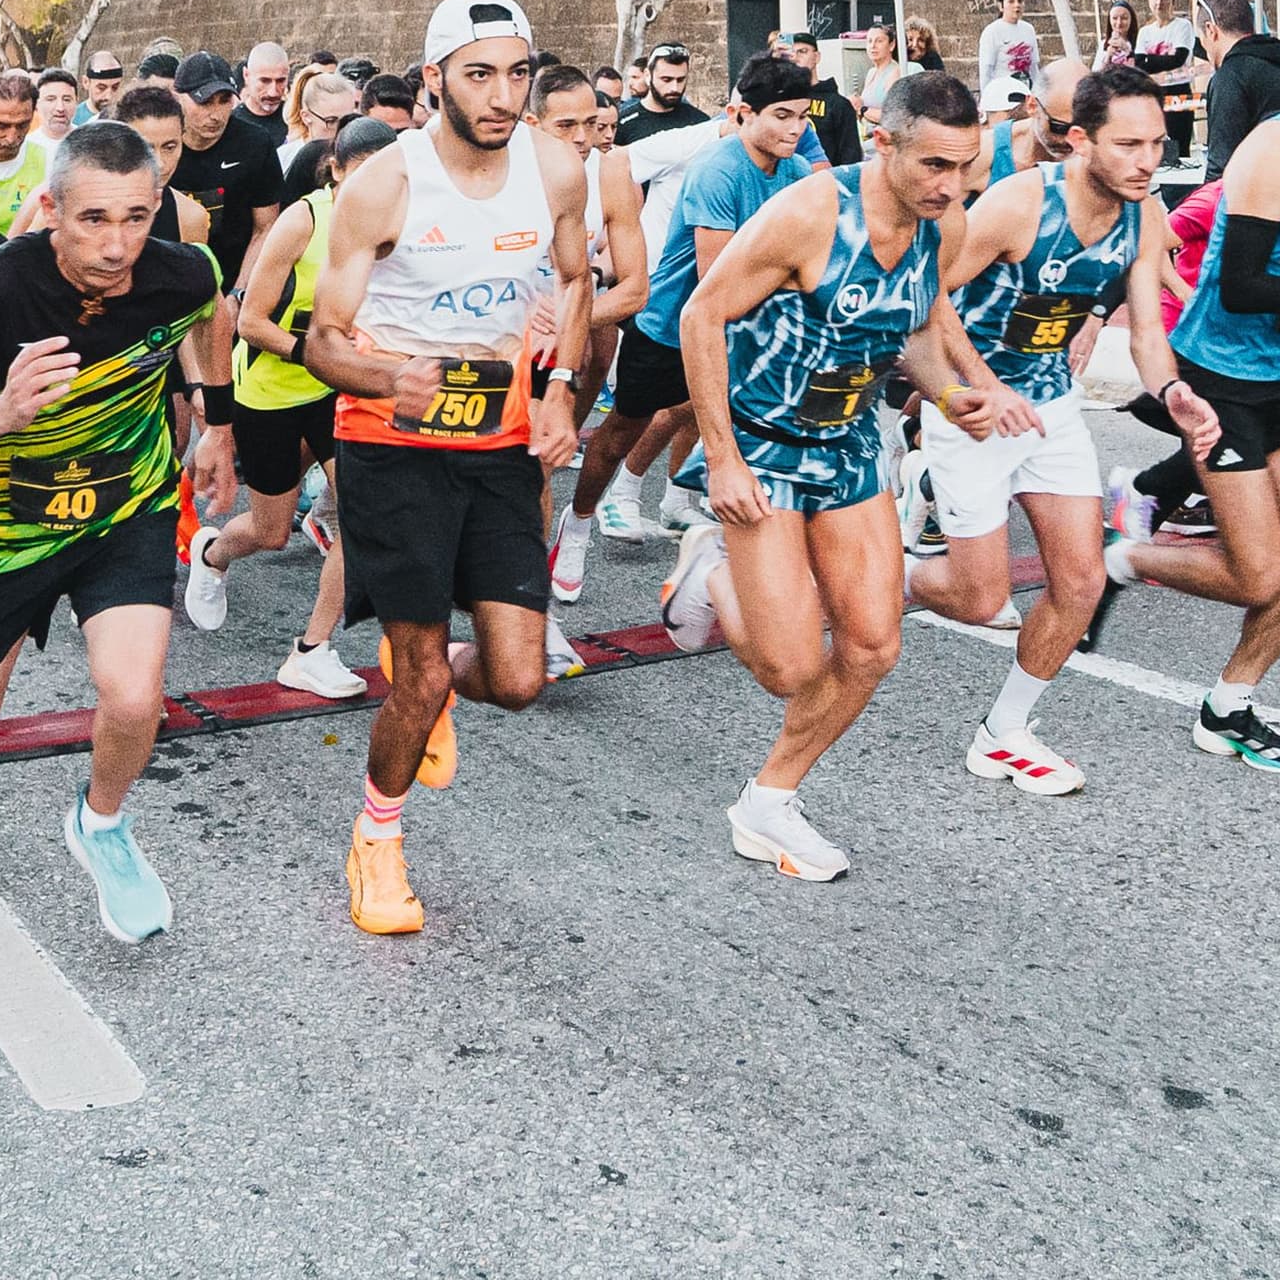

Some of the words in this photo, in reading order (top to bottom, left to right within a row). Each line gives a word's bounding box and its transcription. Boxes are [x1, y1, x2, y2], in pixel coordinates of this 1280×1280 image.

[808, 99, 826, 117] NA
[1031, 320, 1069, 345] 55
[422, 391, 487, 427] 750
[843, 392, 860, 417] 1
[45, 488, 97, 520] 40
